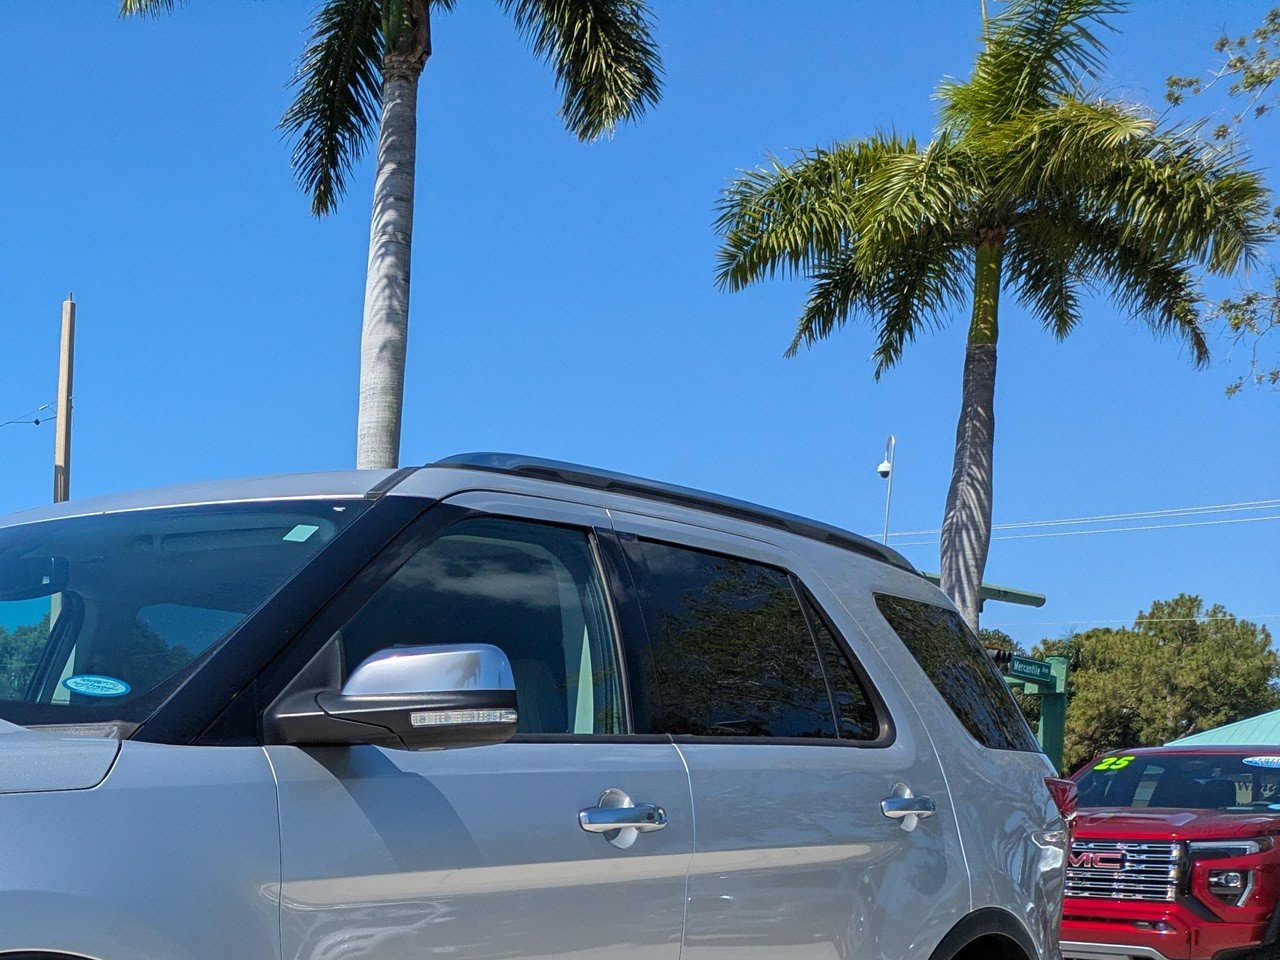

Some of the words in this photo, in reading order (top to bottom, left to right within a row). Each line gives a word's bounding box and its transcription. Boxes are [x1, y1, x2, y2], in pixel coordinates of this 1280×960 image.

[1013, 660, 1041, 675] Mercantile
[1093, 756, 1136, 771] 25
[1069, 852, 1122, 869] MC
